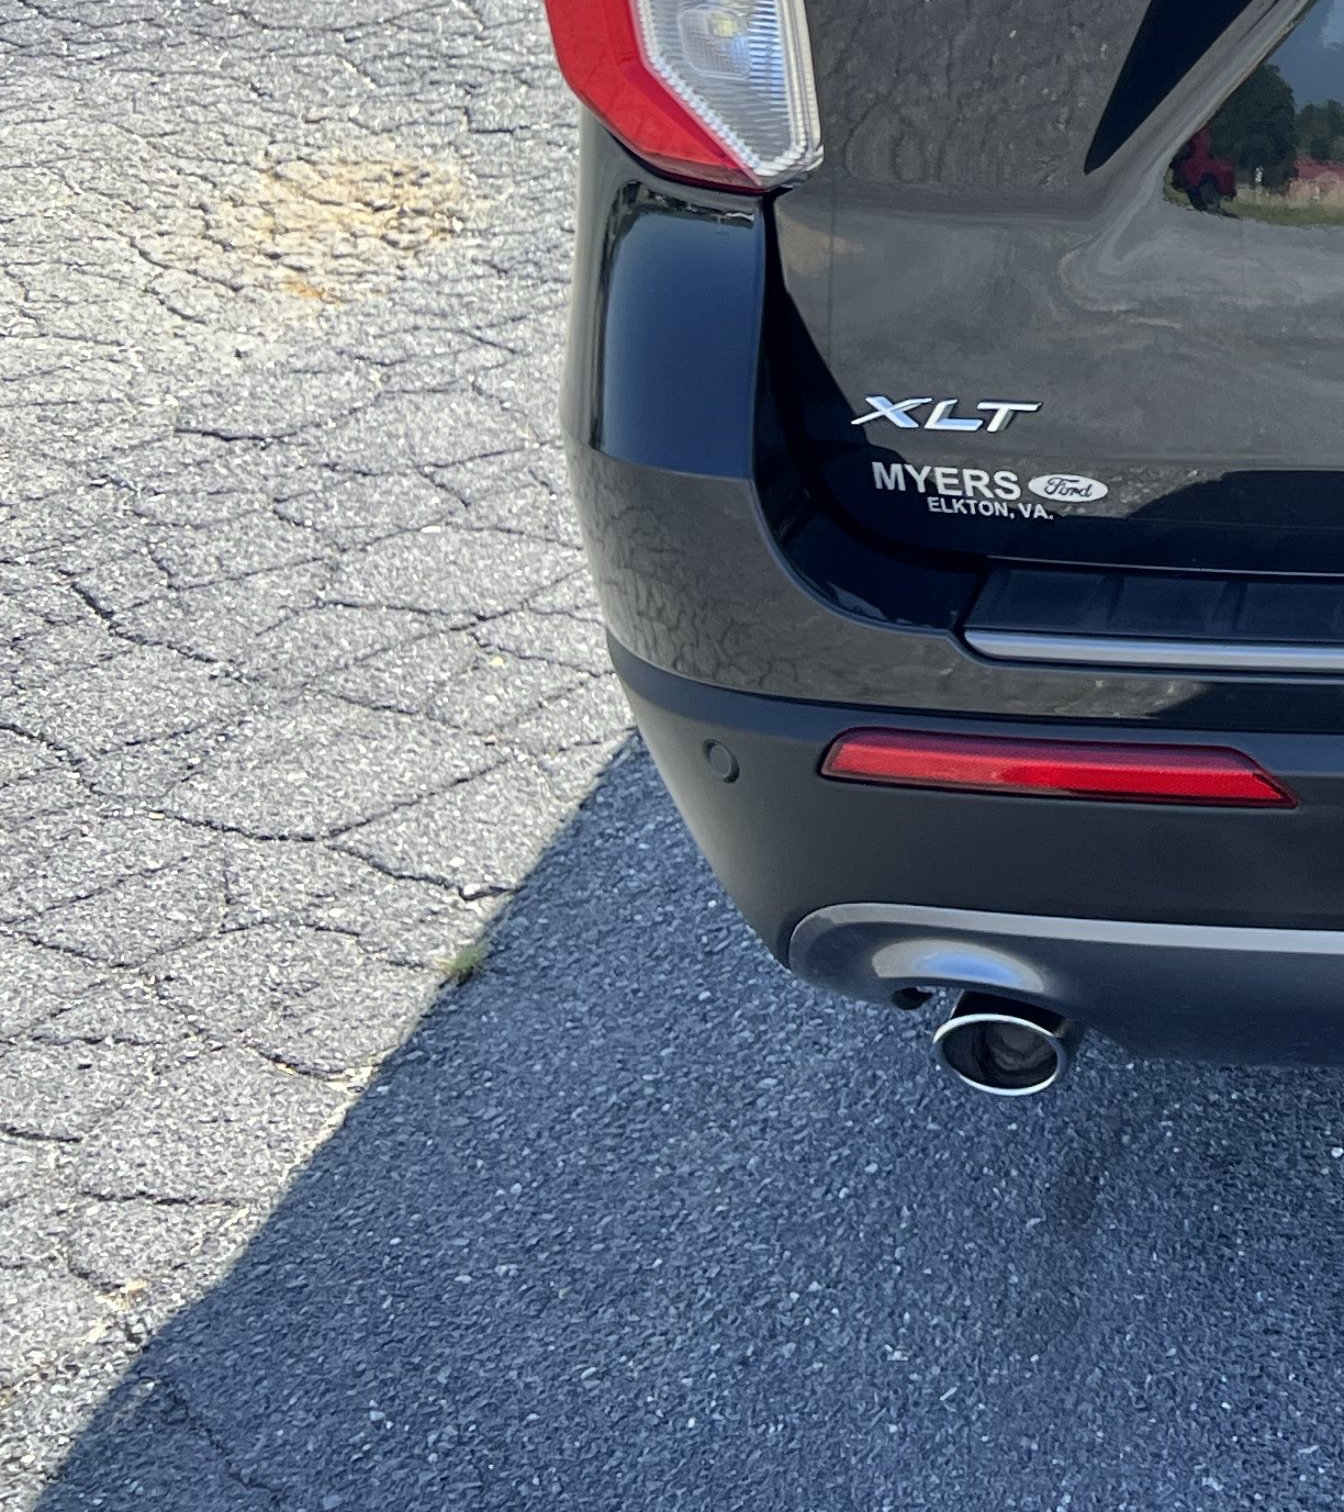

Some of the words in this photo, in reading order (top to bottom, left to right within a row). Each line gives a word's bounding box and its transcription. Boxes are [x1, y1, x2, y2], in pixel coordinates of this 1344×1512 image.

[850, 394, 1043, 433] XLT
[871, 461, 1022, 501] MYERS
[1043, 476, 1093, 498] Ford
[926, 495, 1015, 520] ELKTON,
[1018, 501, 1054, 521] VA.
